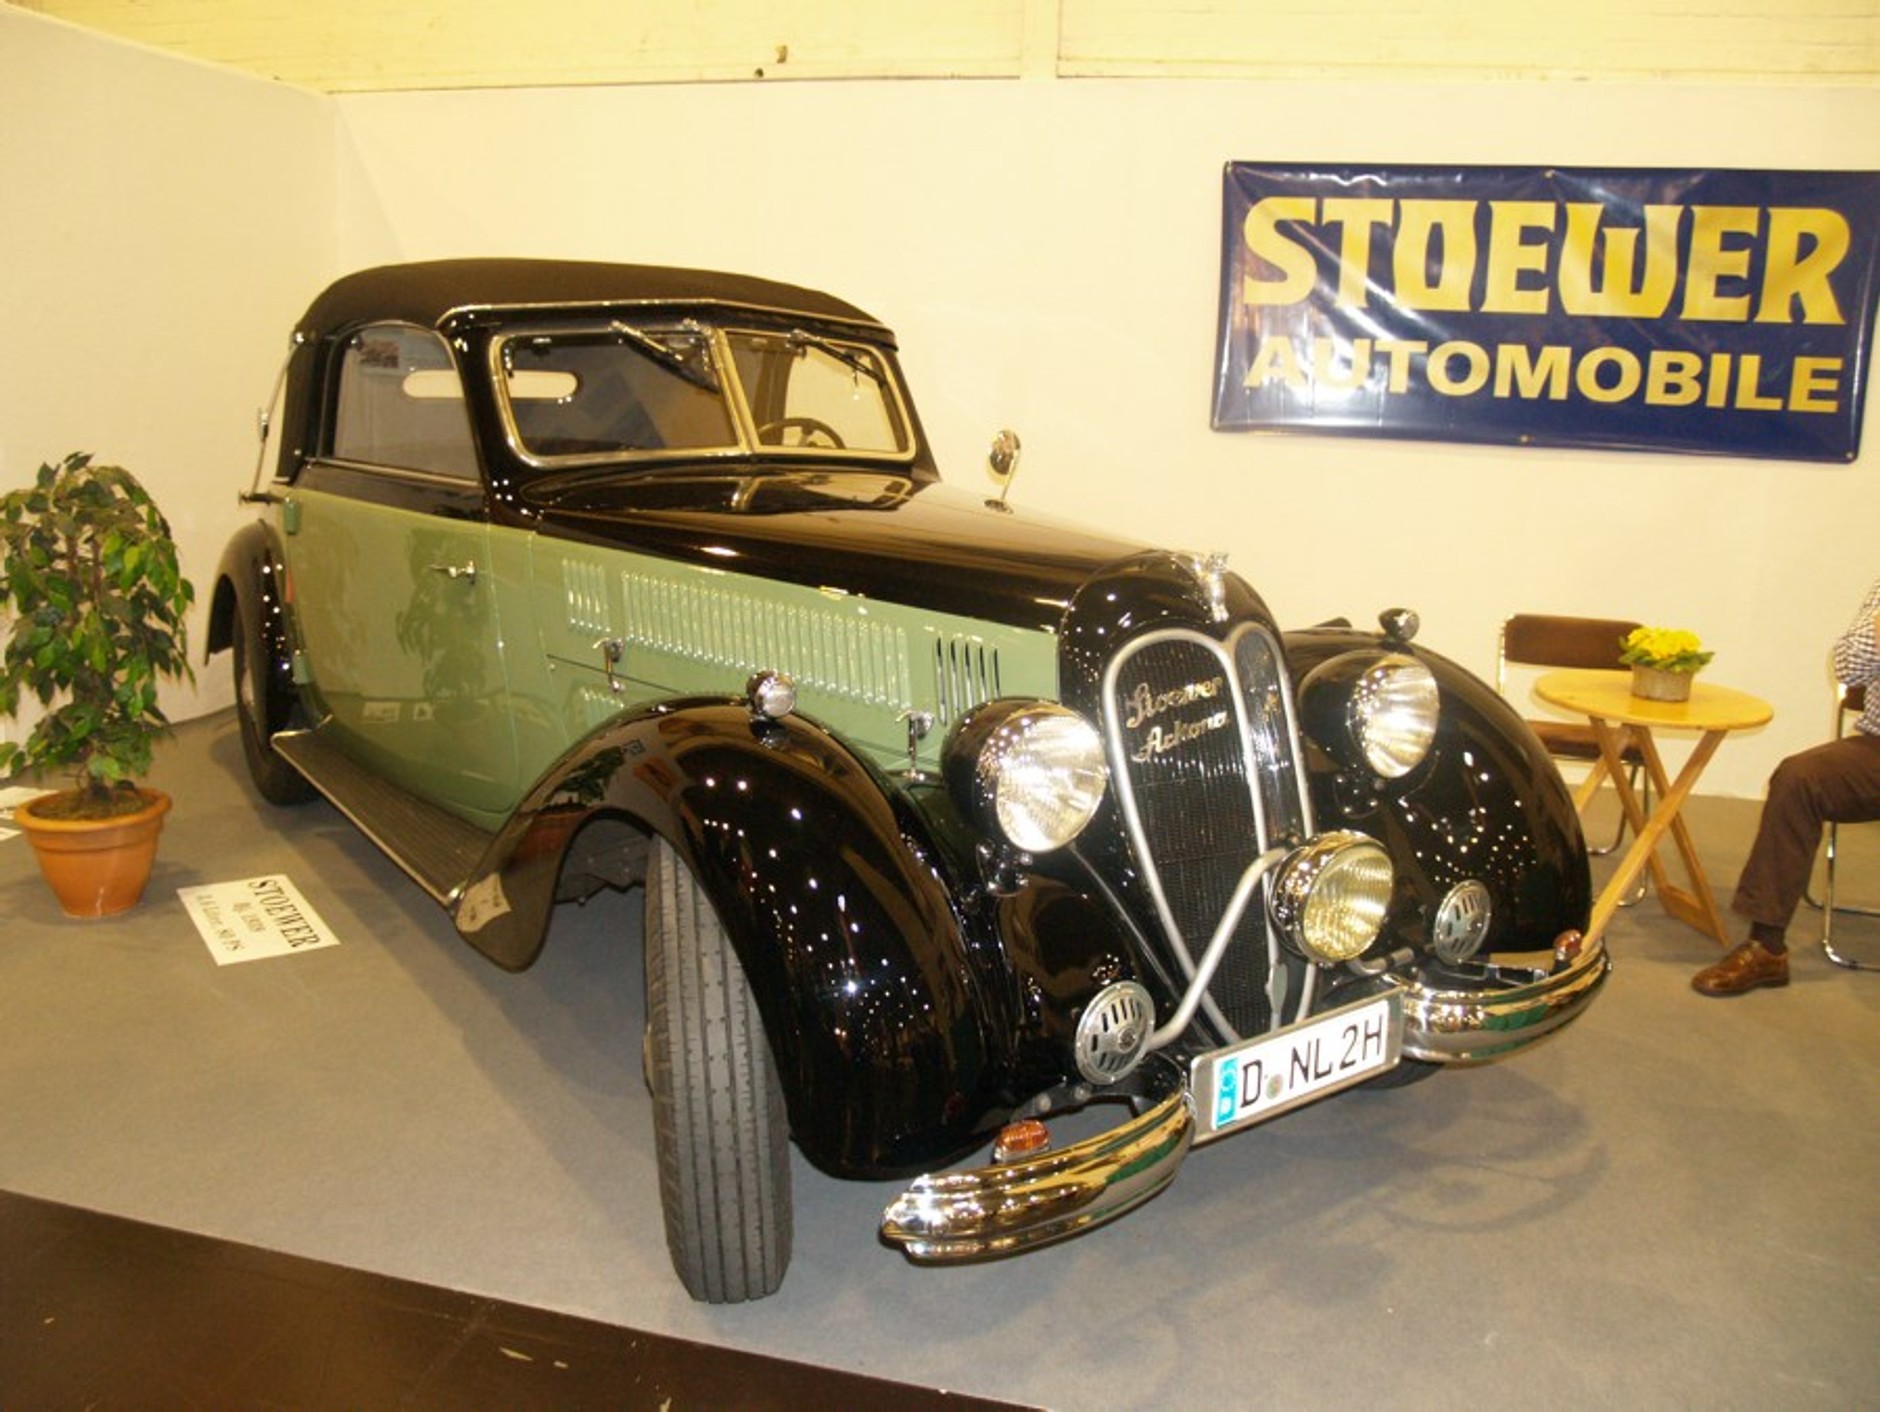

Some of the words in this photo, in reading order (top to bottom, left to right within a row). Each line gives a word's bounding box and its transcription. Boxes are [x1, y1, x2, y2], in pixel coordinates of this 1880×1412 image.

[1242, 196, 1851, 324] STOEWER
[1244, 335, 1842, 413] AUTOMOBILE
[248, 879, 321, 948] STOEWER
[1241, 1059, 1262, 1108] D
